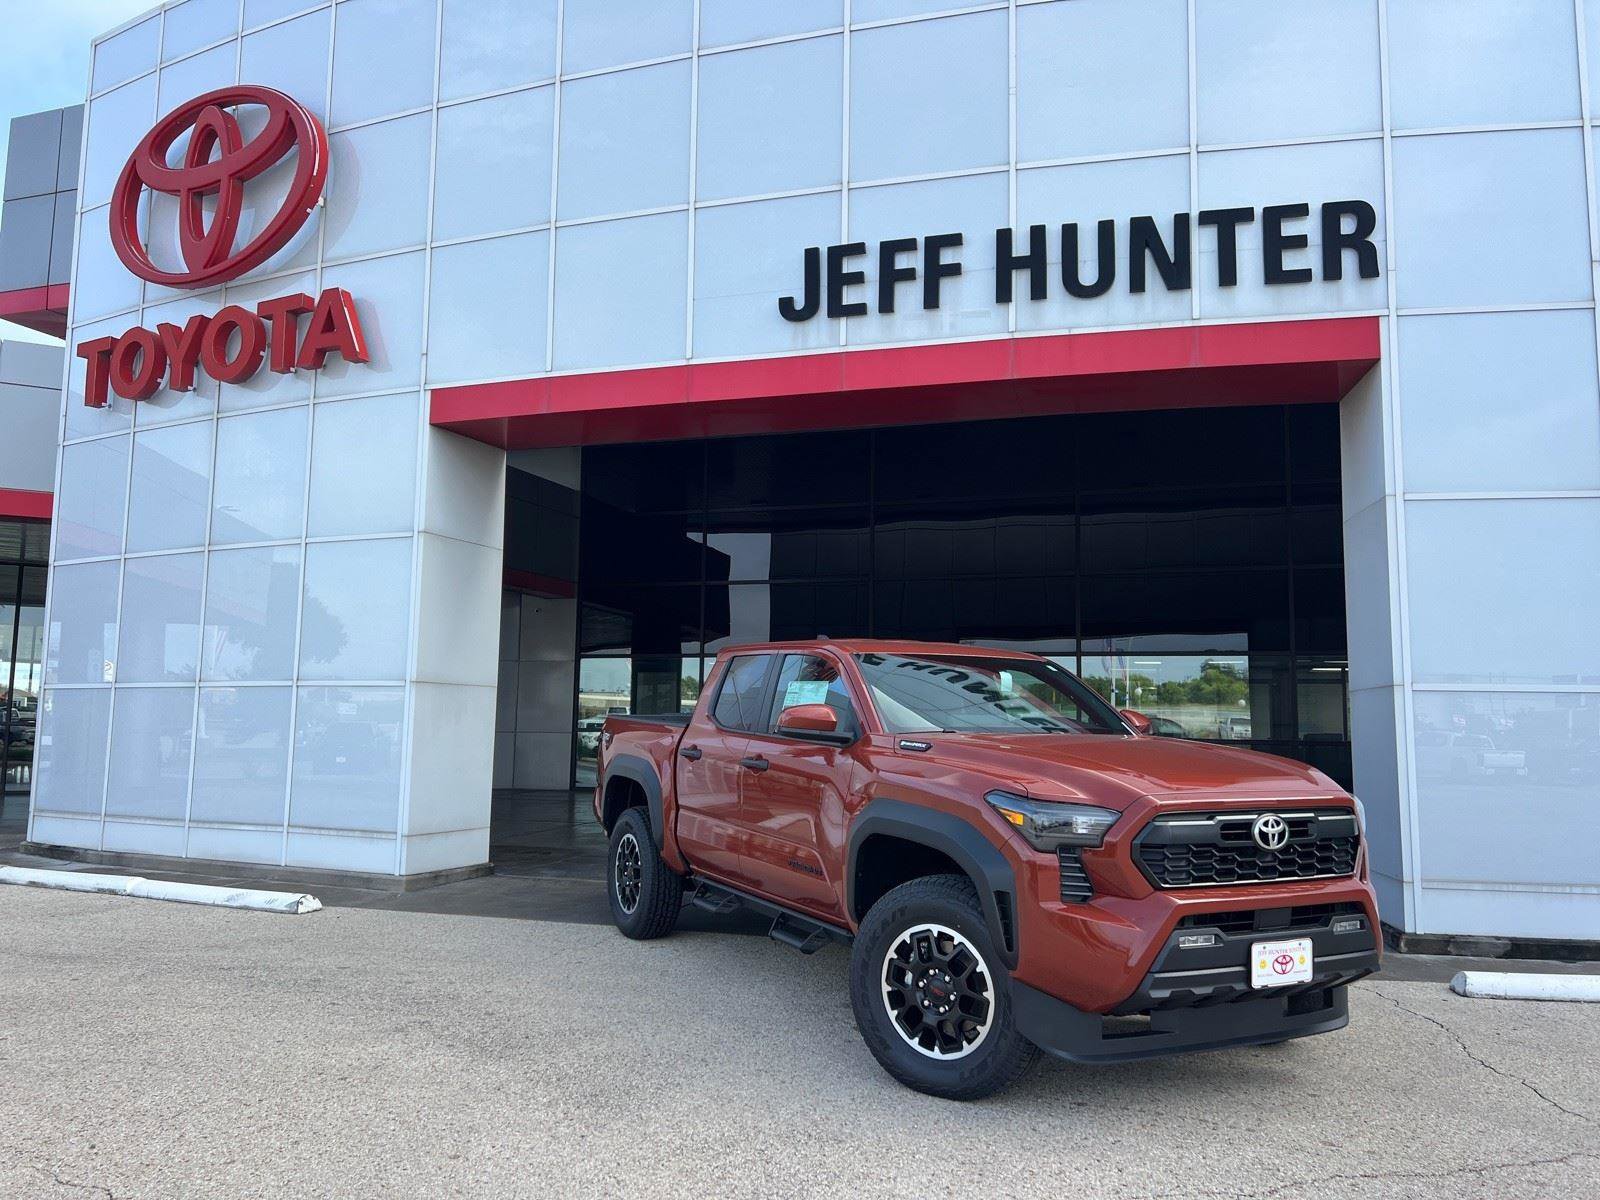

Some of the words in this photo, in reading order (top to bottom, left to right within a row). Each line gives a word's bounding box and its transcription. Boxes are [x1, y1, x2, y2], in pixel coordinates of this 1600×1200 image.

[778, 232, 963, 322] JEFF
[996, 200, 1380, 304] HUNTER
[77, 287, 369, 408] TOYOTA
